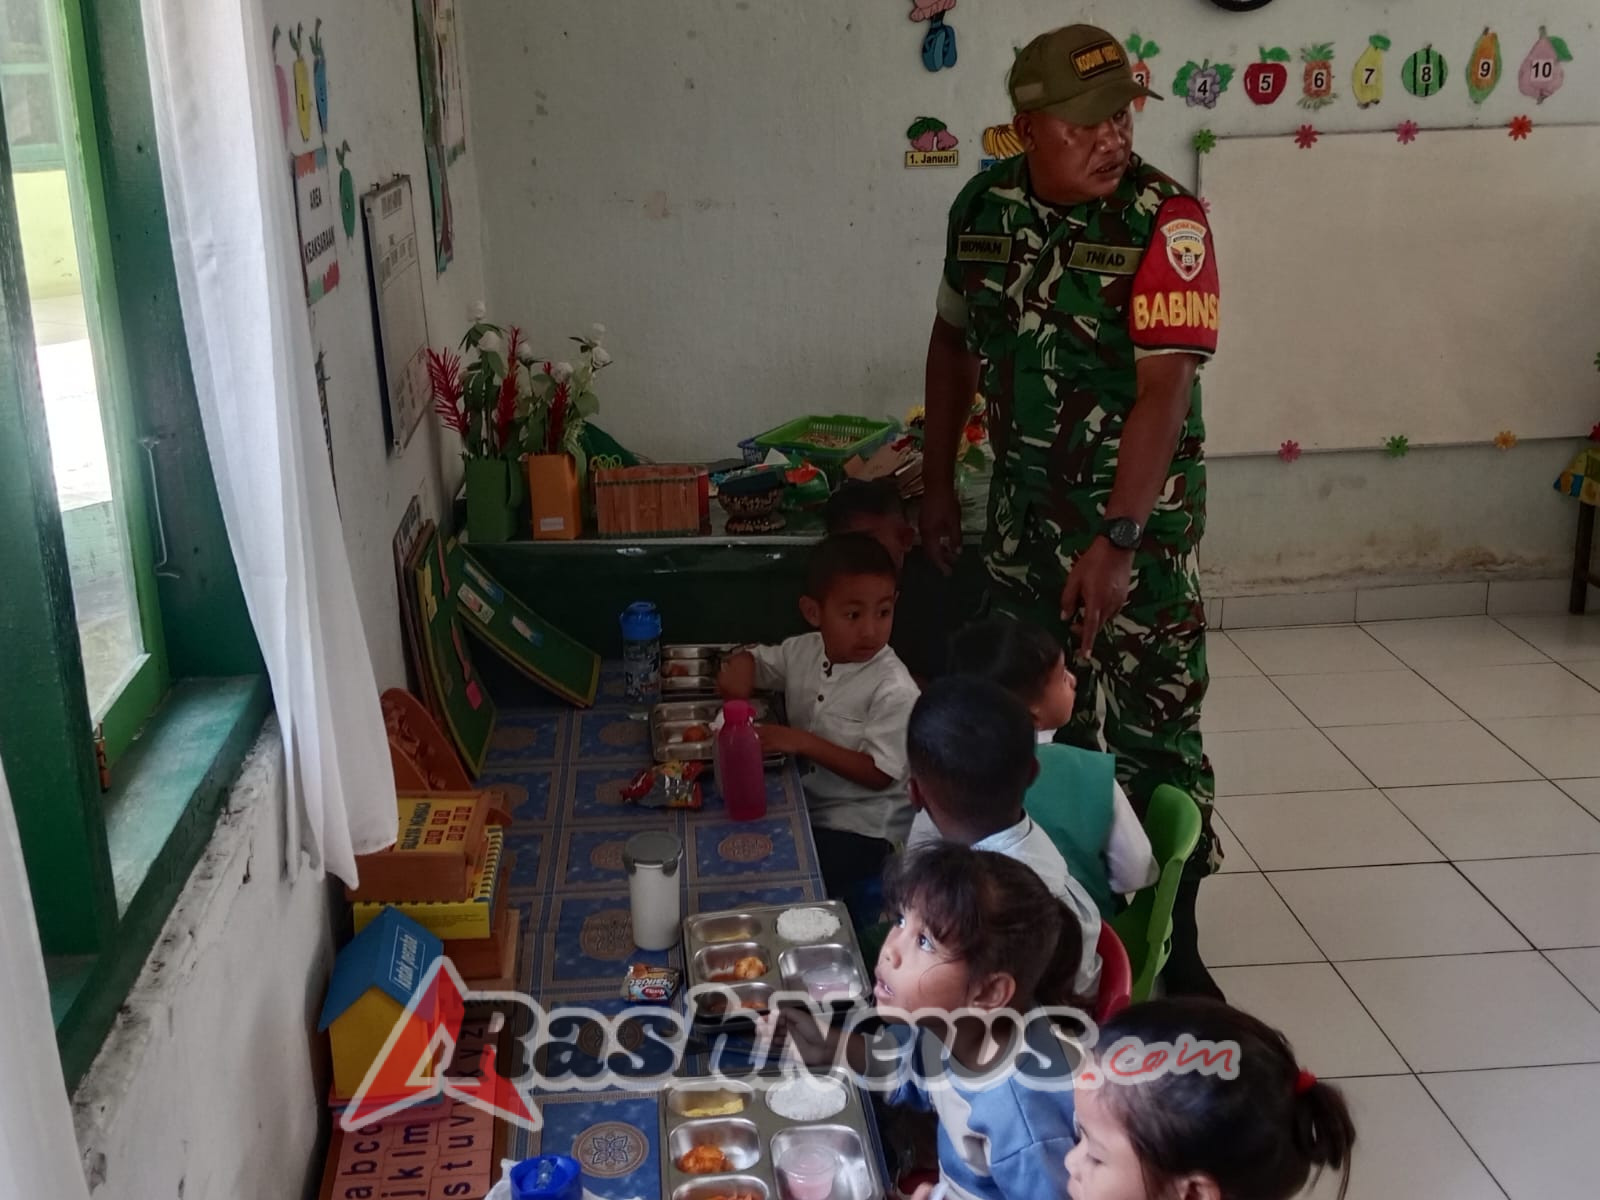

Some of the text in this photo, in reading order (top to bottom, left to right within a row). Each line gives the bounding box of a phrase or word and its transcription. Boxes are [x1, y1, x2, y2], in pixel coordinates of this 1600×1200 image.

[1363, 68, 1375, 84] 7
[1421, 66, 1432, 82] 8
[1479, 61, 1491, 77] 9
[1531, 61, 1552, 79] 10
[1197, 79, 1209, 96] 4
[1260, 75, 1272, 91] 5
[1313, 71, 1325, 88] 6
[909, 153, 956, 164] 1. Januari
[1133, 291, 1219, 331] BABINS
[450, 1115, 475, 1127] v
[403, 1123, 430, 1145] m
[448, 1135, 474, 1149] u
[354, 1141, 380, 1154] c
[341, 1159, 378, 1176] b
[387, 1165, 425, 1181] k
[440, 1160, 473, 1171] t
[345, 1185, 374, 1200] a
[443, 1181, 471, 1197] s
